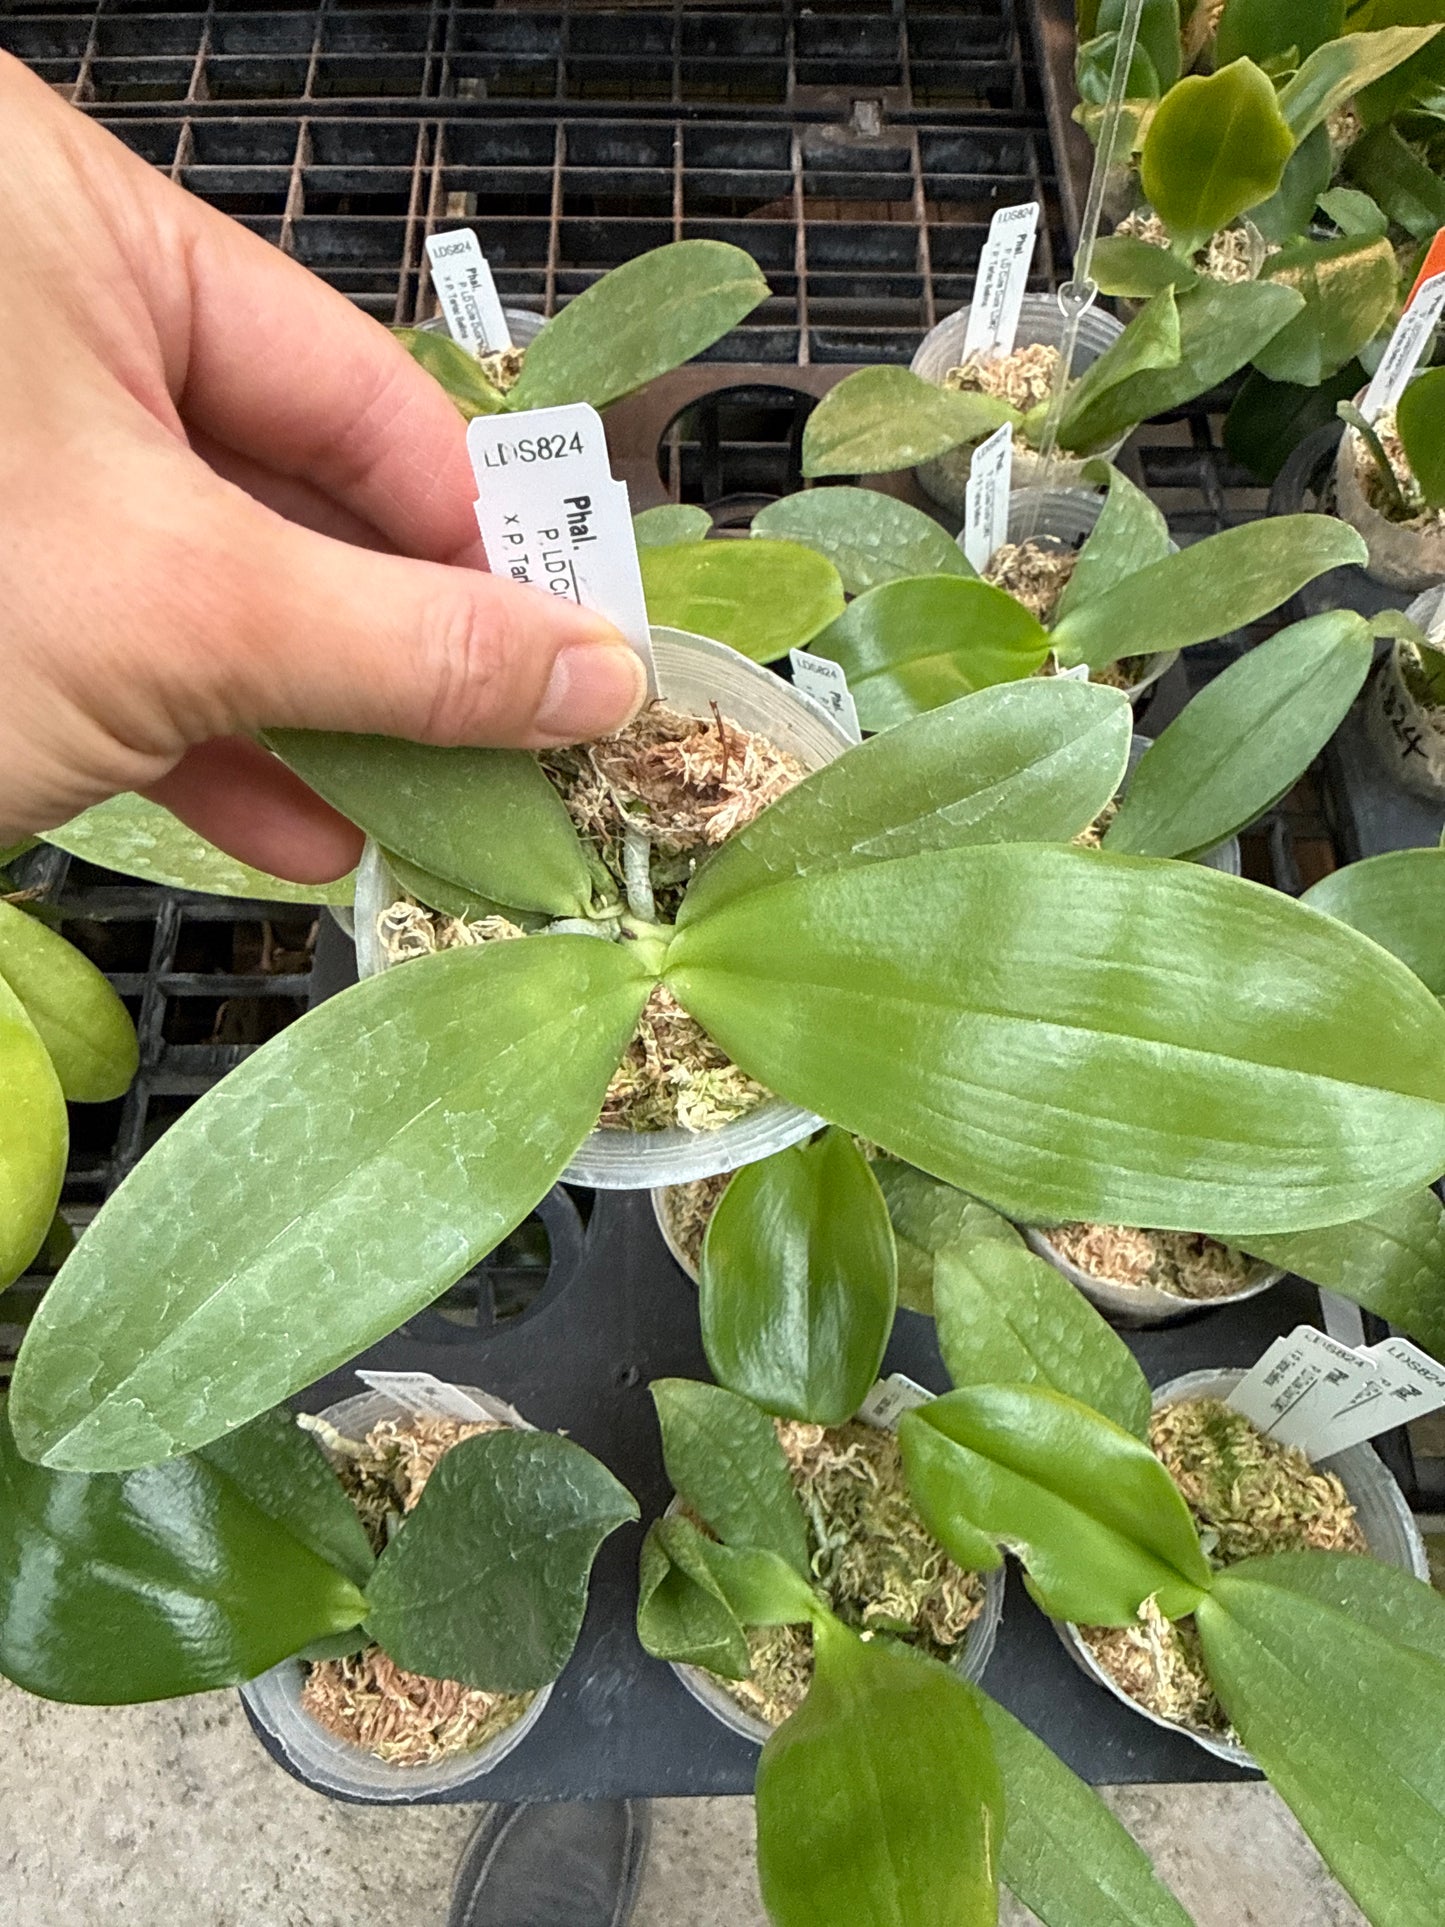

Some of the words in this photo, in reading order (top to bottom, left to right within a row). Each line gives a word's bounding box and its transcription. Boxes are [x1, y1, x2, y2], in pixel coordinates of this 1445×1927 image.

[484, 431, 585, 468] LDS824
[563, 495, 598, 551] Phal.
[542, 549, 566, 574] LD
